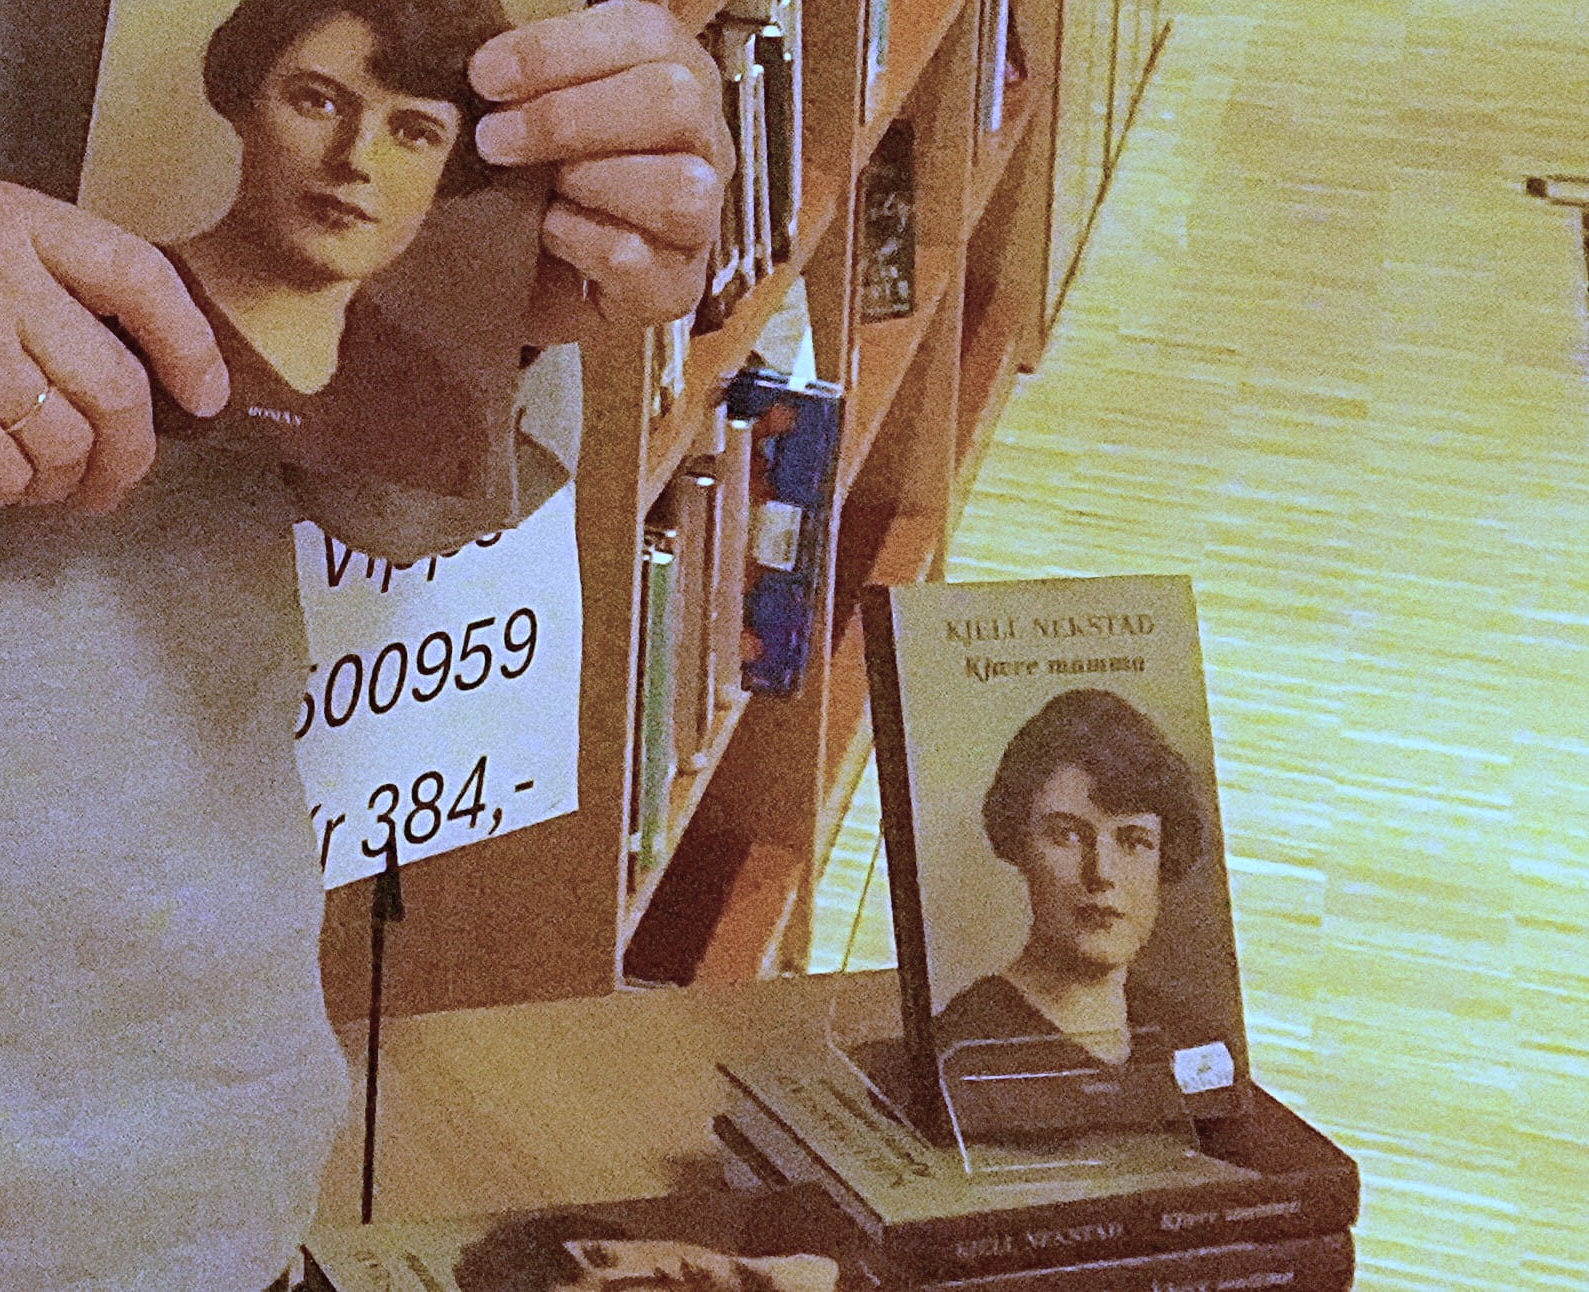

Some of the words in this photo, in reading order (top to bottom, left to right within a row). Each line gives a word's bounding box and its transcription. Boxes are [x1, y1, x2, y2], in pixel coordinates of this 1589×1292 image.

[943, 617, 1018, 648] KJELL
[1031, 613, 1156, 639] NEKSTAD
[309, 802, 346, 872] r
[361, 754, 535, 859] 384,-
